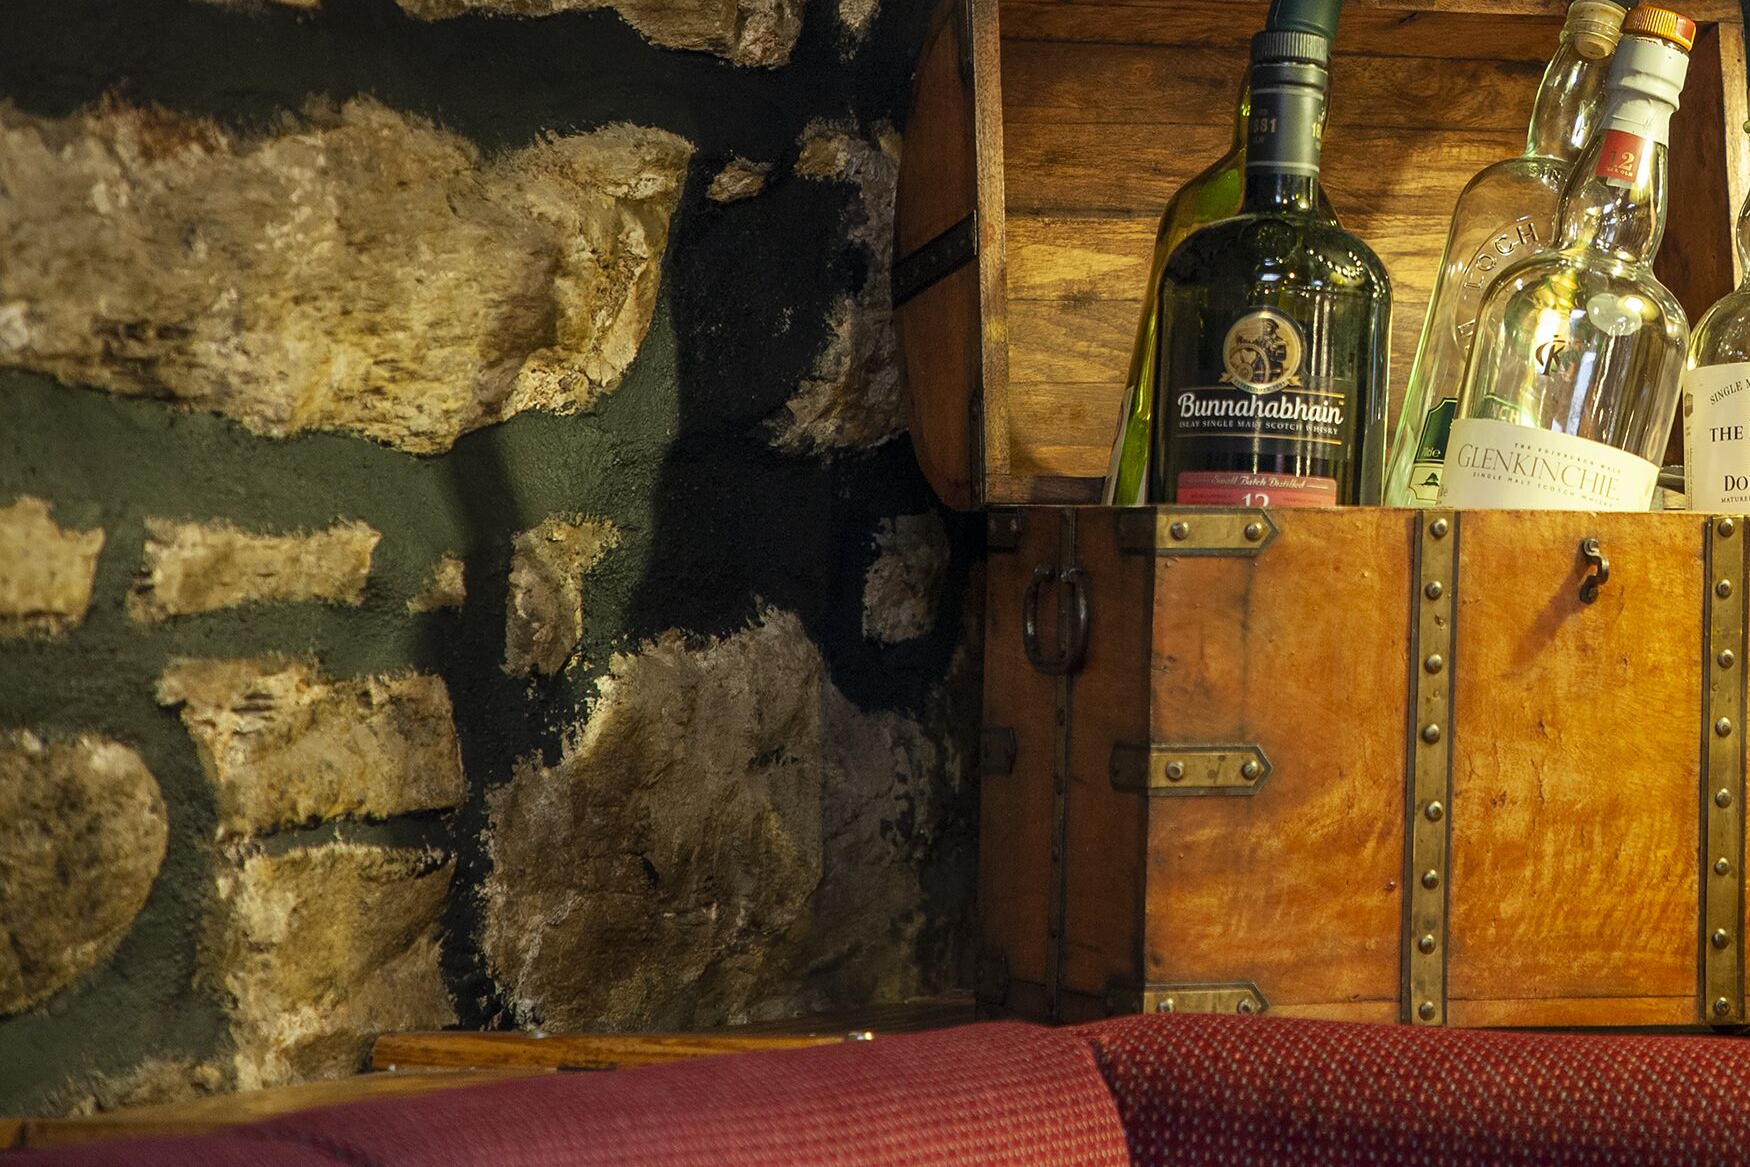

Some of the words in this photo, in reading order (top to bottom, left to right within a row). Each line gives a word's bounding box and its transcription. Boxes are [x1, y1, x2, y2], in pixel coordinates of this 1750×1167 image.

[1464, 222, 1539, 290] LOCH
[1710, 381, 1742, 405] SINGLE
[1177, 392, 1343, 425] Bunnahabhain
[1179, 420, 1200, 428] ISLAY
[1202, 419, 1233, 428] SINGLE
[1237, 419, 1261, 429] MALT
[1265, 421, 1300, 431] SCOTCH
[1305, 425, 1338, 435] WHISKY
[1709, 425, 1744, 443] THE
[1211, 475, 1238, 484] Small
[1241, 476, 1266, 487] Batch
[1270, 477, 1306, 489] Distilled
[1457, 443, 1620, 501] GLENKINCHIE
[1473, 471, 1501, 481] SINGLE
[1508, 477, 1531, 486] MALT
[1538, 483, 1575, 497] SCOTCH
